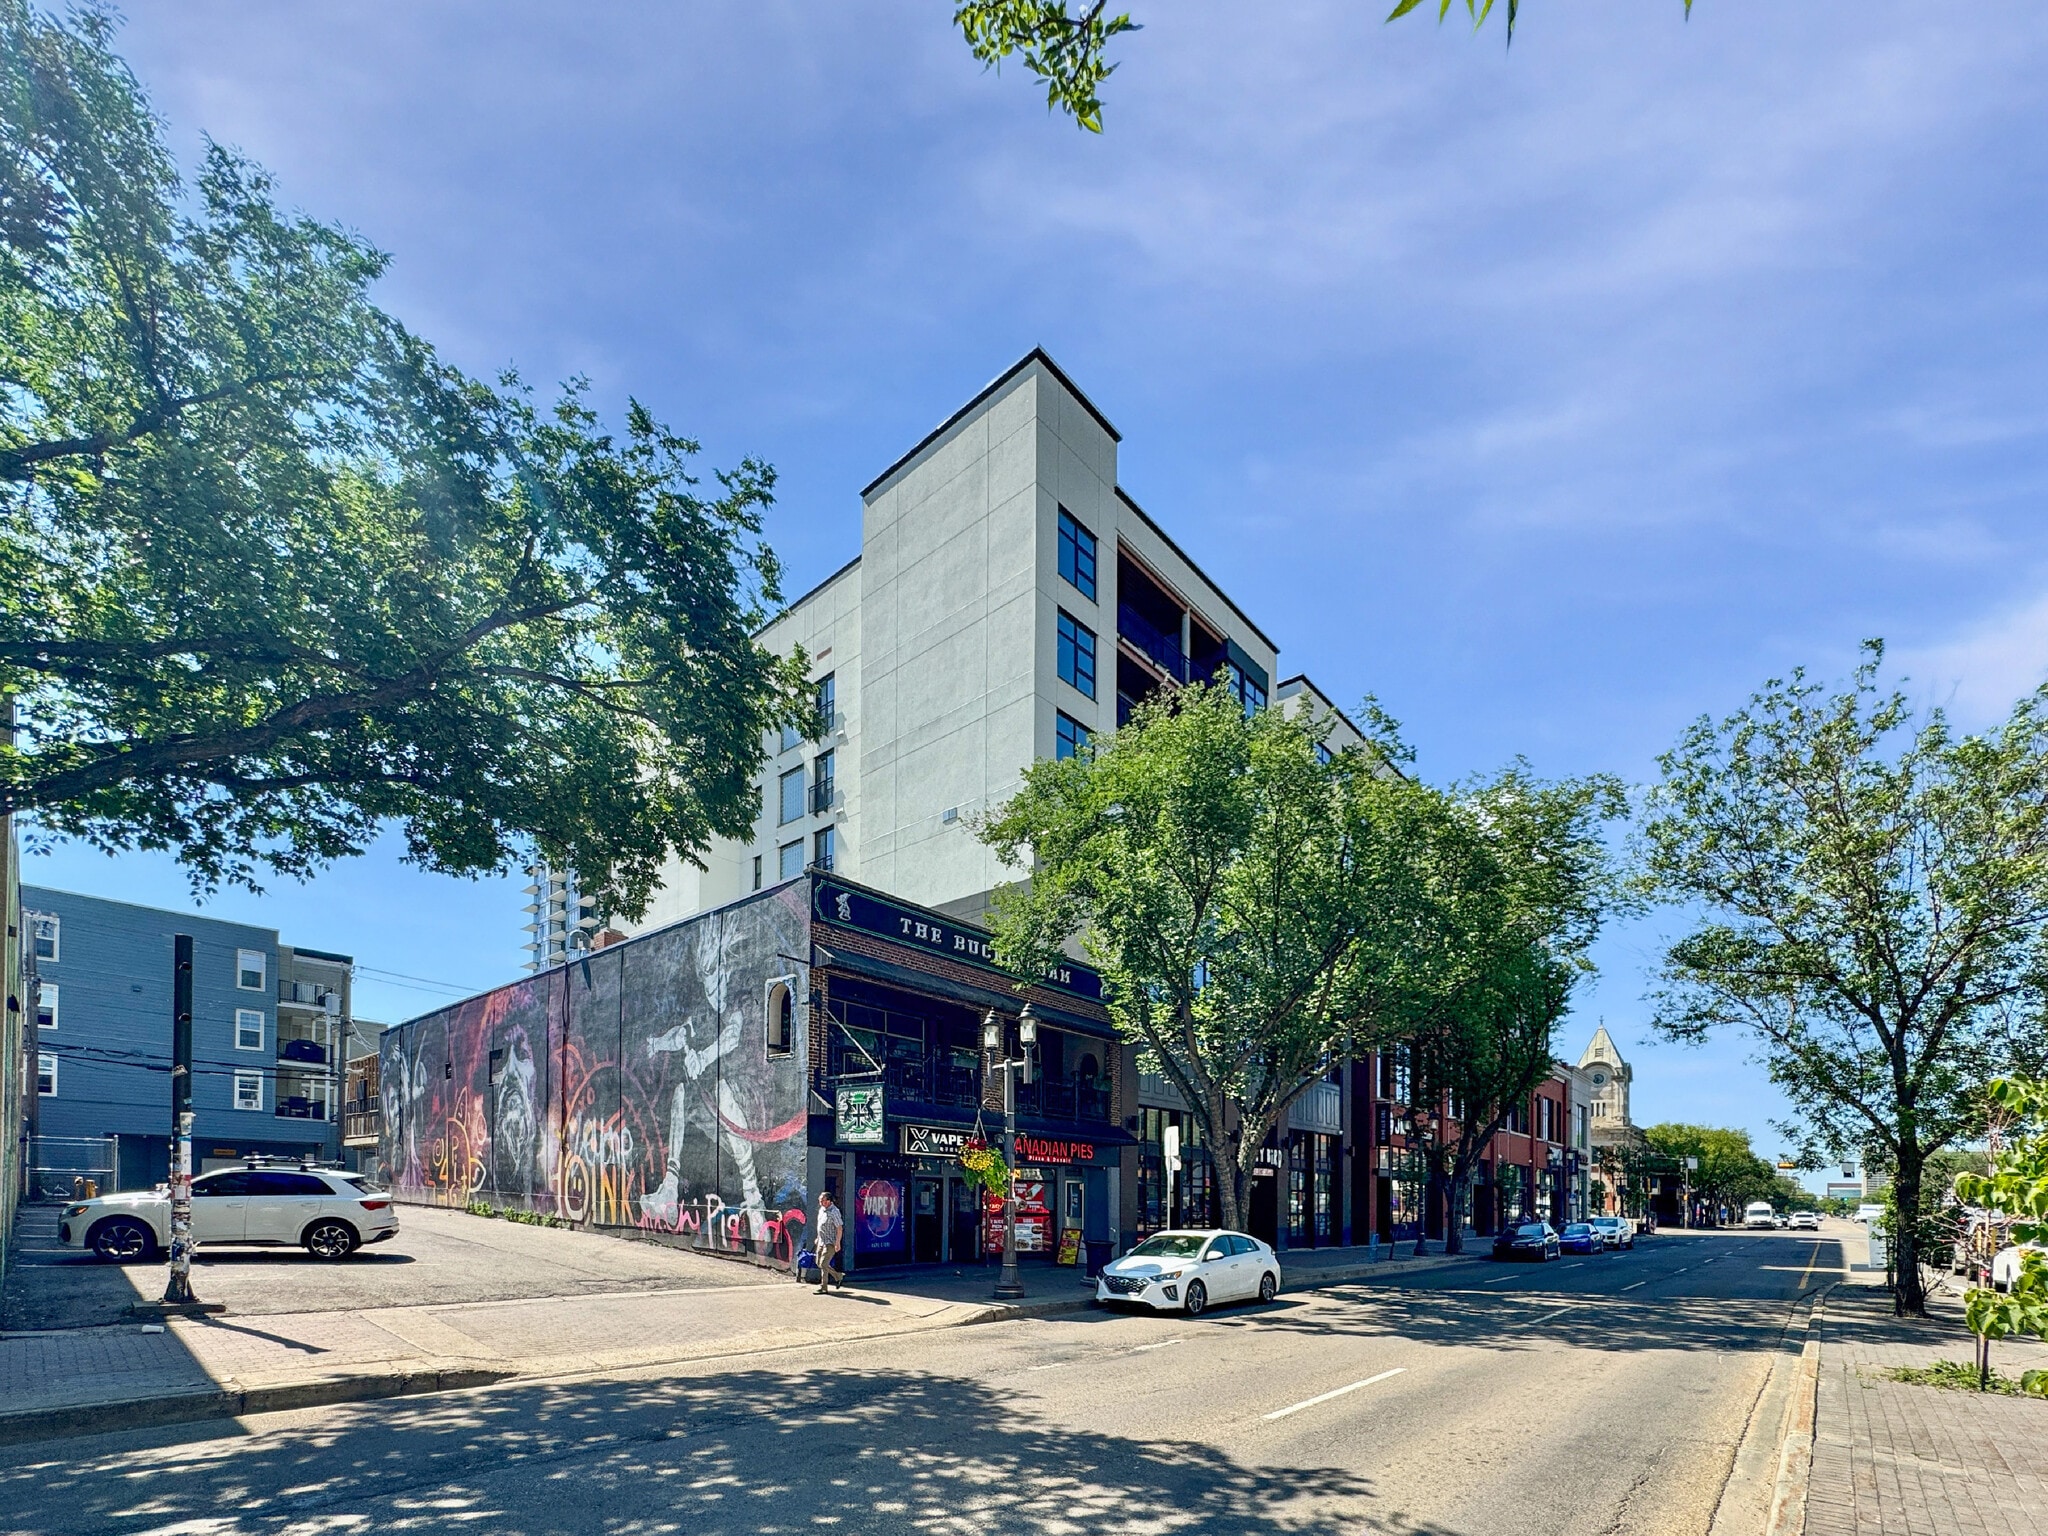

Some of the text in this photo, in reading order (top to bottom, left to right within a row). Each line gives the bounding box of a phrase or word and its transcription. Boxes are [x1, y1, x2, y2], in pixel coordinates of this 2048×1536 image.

[900, 917, 943, 945] THE
[931, 1132, 964, 1147] VAPE
[1014, 1137, 1094, 1159] ANADIAN PIES
